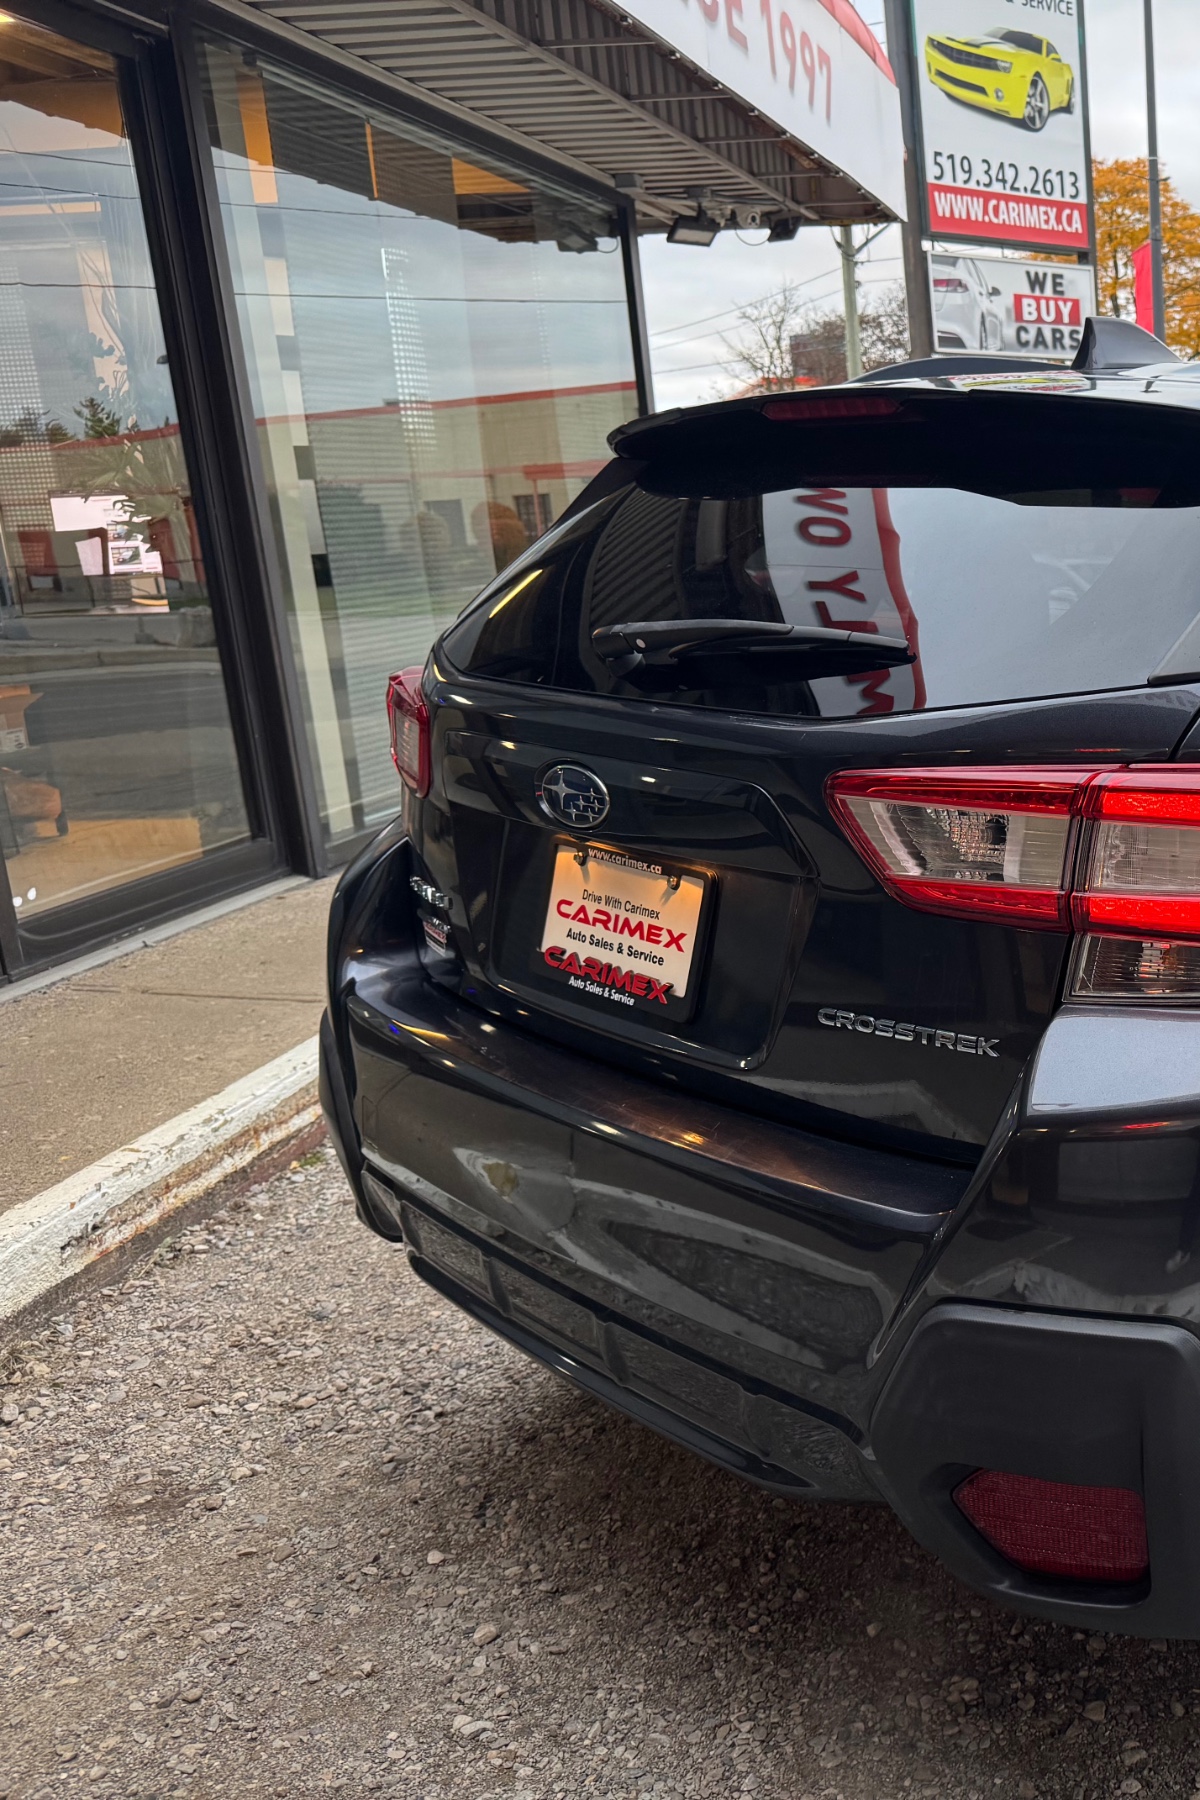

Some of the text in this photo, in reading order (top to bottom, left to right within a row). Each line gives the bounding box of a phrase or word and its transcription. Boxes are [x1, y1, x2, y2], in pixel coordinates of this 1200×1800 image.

[760, 0, 832, 122] 1997
[933, 151, 1080, 200] 519.342.2613
[933, 190, 1083, 234] WWW.CARIMEX.CA
[1026, 270, 1065, 296] WE
[1021, 297, 1073, 324] BUY
[1016, 325, 1081, 351] CARS
[588, 848, 662, 875] www.carimex.ca
[582, 889, 660, 920] Drive With Carimex
[556, 899, 687, 952] CARIMEX
[566, 927, 664, 966] Auto Sales & Service
[544, 946, 672, 1004] CARIMEX
[569, 976, 635, 1006] Auto Sales & Service
[817, 1007, 1000, 1057] CROSSTREK
